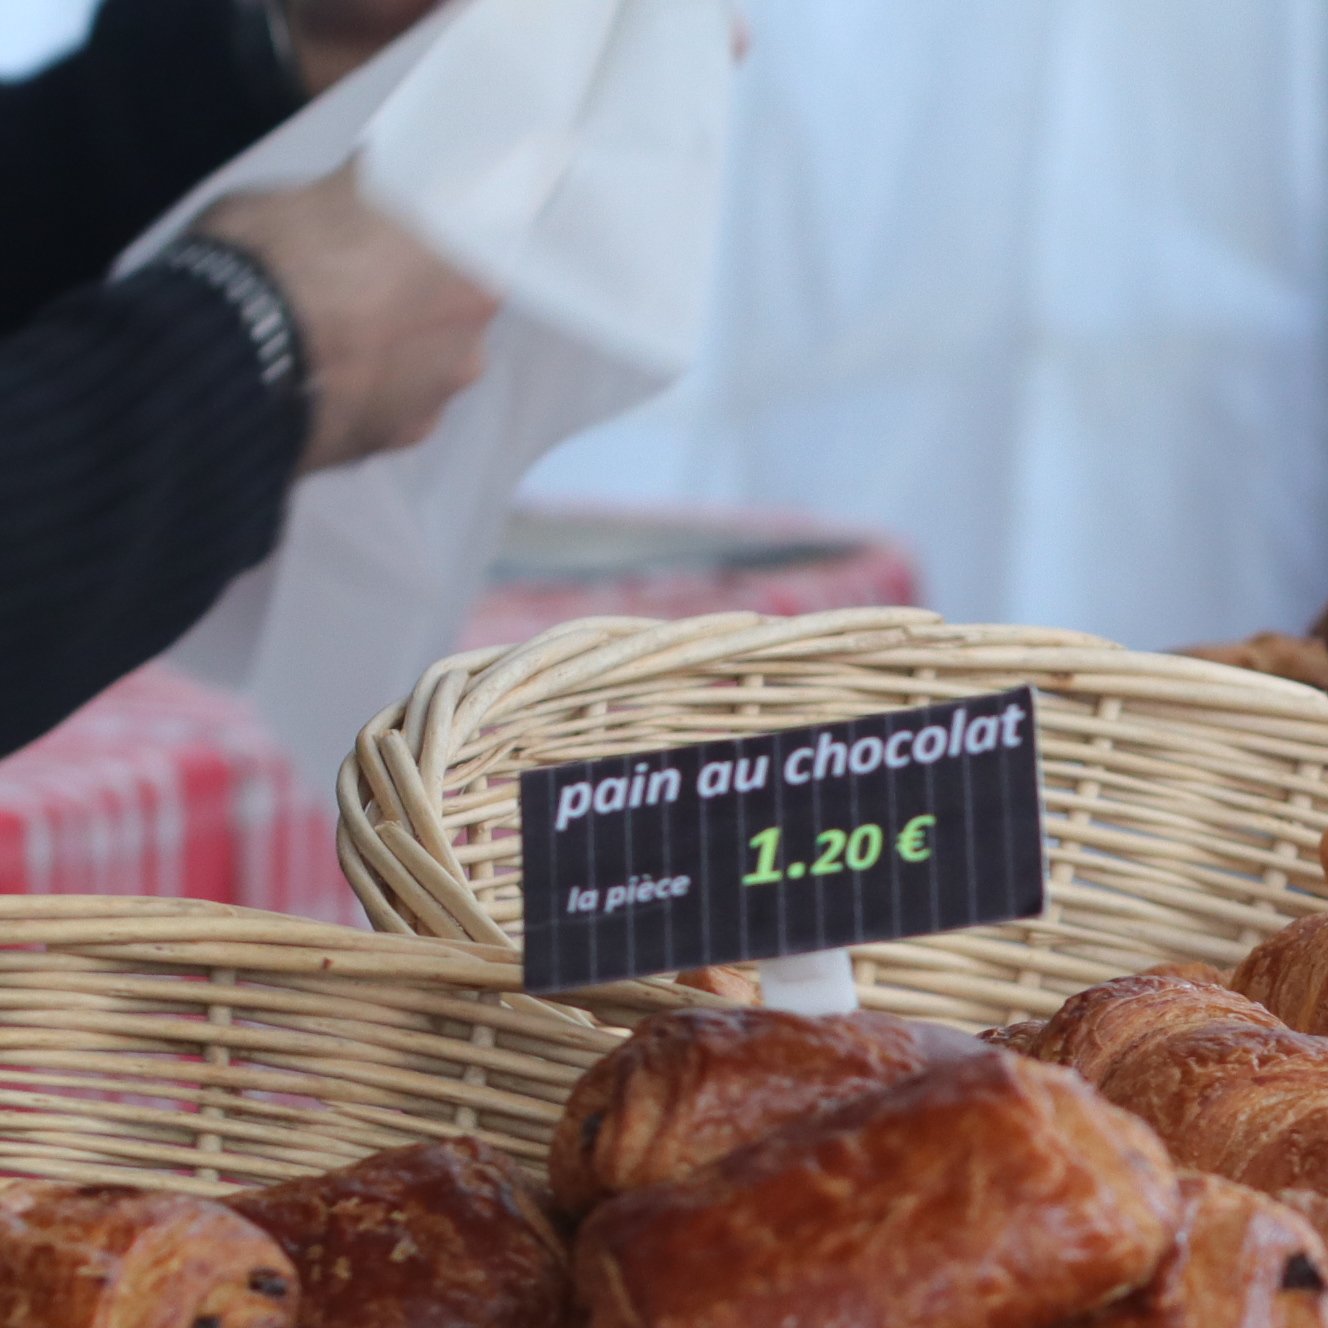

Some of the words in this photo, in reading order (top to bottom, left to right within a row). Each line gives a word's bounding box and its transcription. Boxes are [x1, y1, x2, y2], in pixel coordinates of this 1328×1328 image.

[555, 763, 682, 830] pain
[696, 755, 769, 799] au
[783, 703, 1027, 786] chocolat
[566, 886, 598, 914] la
[604, 872, 690, 914] pièce
[741, 825, 884, 886] 1.20
[896, 814, 936, 863] €
